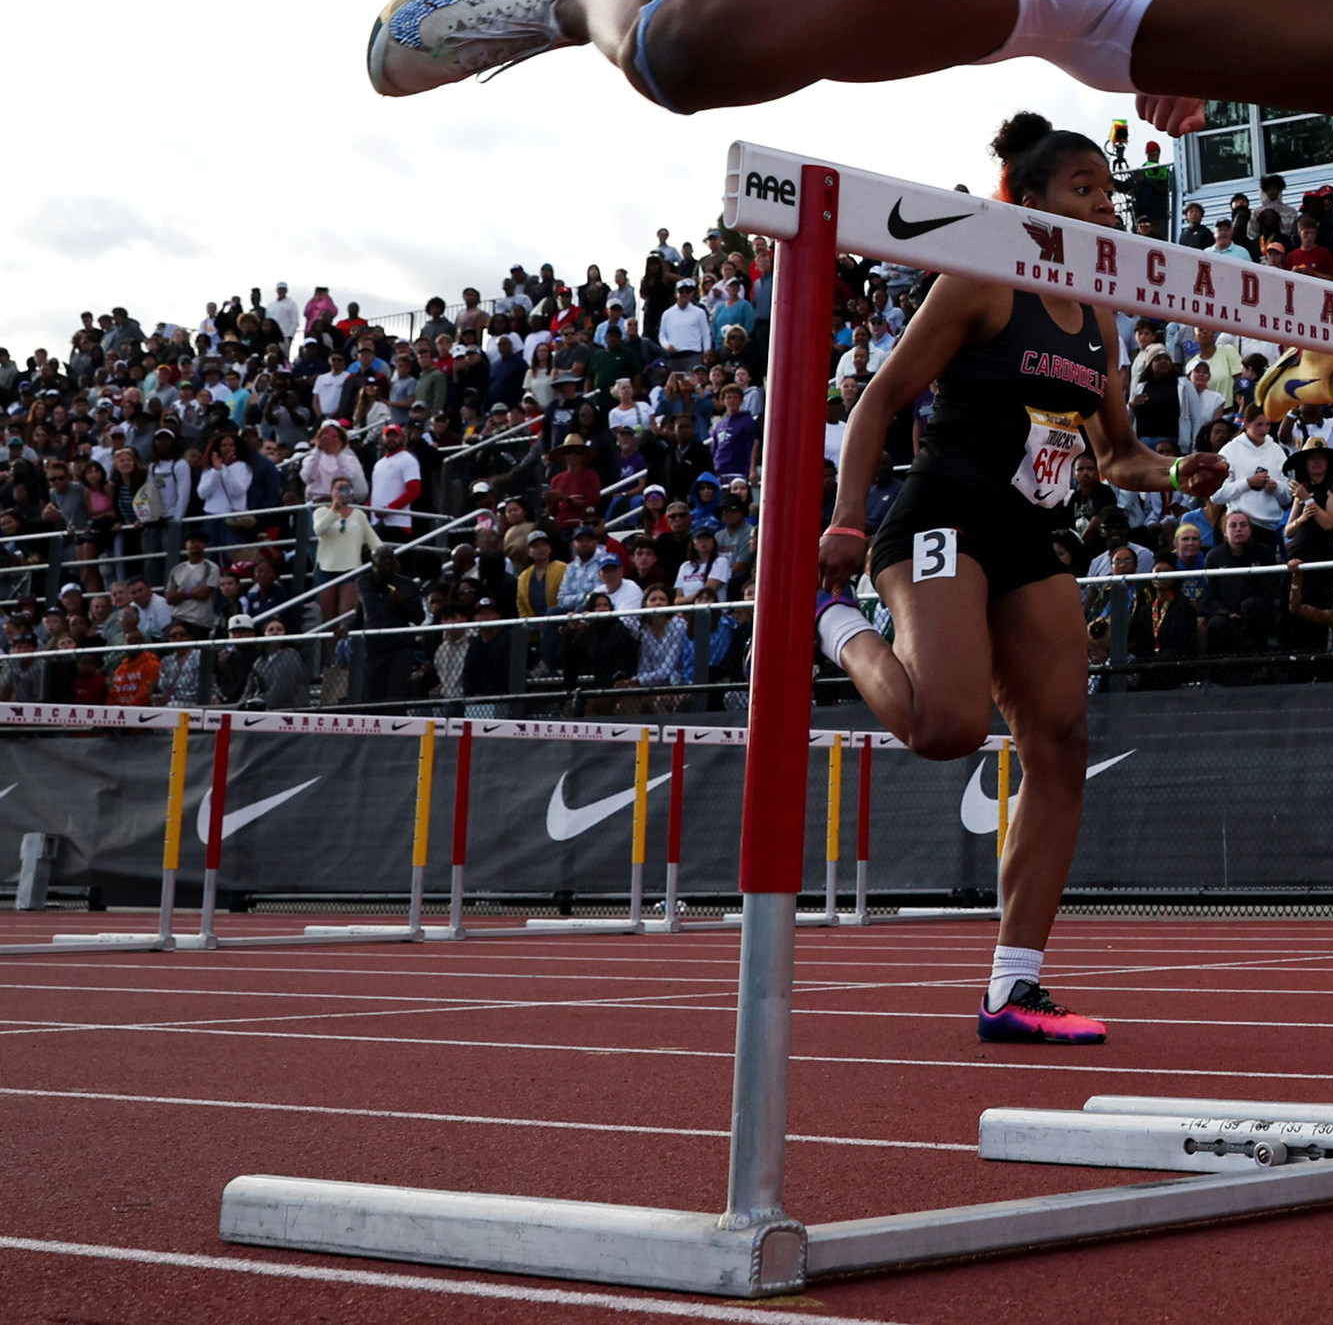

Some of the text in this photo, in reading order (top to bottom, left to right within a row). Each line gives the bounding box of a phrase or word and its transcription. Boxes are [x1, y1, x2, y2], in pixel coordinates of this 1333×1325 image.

[1015, 260, 1075, 287] HOME
[1094, 278, 1117, 296] OF
[1136, 287, 1242, 323] NATIONAL
[1047, 429, 1077, 449] TRUCKS
[1032, 447, 1069, 486] 647
[921, 531, 946, 577] 3
